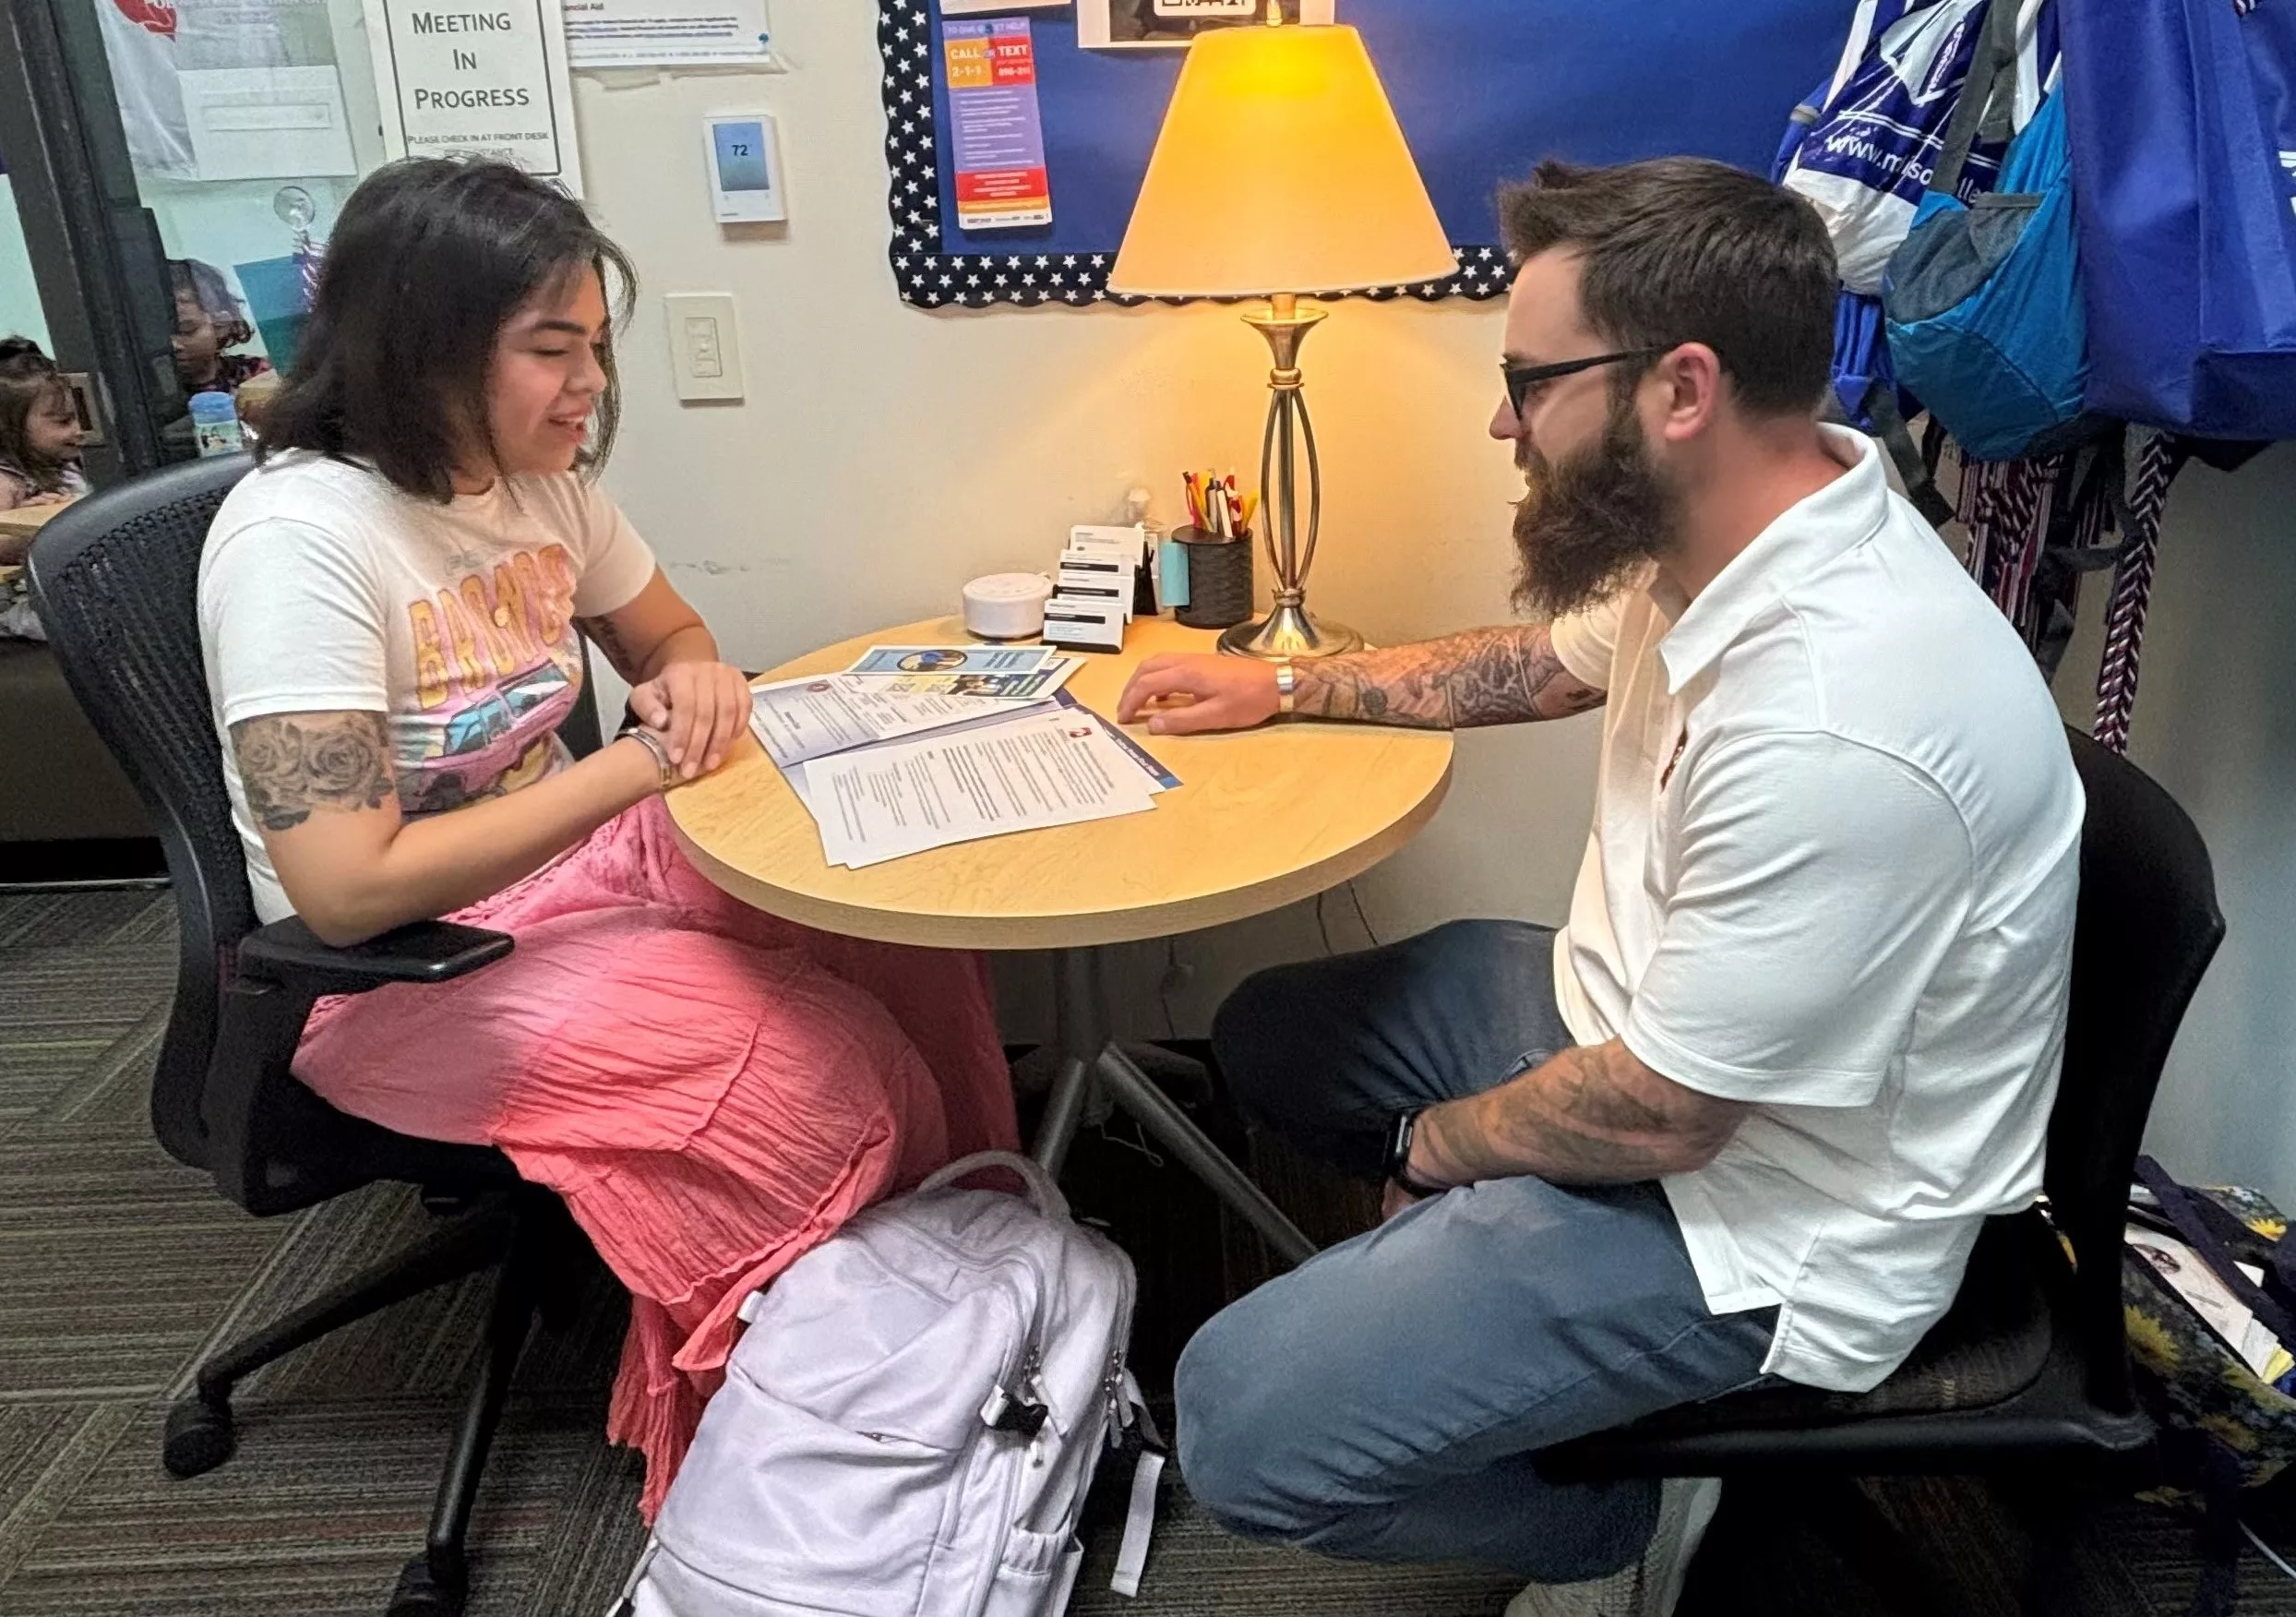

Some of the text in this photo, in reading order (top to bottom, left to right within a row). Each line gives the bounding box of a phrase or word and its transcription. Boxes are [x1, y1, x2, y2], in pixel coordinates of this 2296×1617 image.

[412, 12, 511, 34] MEETING
[951, 47, 981, 60] CALL
[997, 44, 1028, 57] TEXT
[951, 66, 982, 78] 2-1-1
[414, 88, 530, 110] PROGRESS
[407, 136, 438, 144] PLEASE
[441, 135, 468, 143] CHECK
[481, 133, 492, 141] AT
[494, 132, 522, 141] FRONT
[524, 132, 549, 140] DESK
